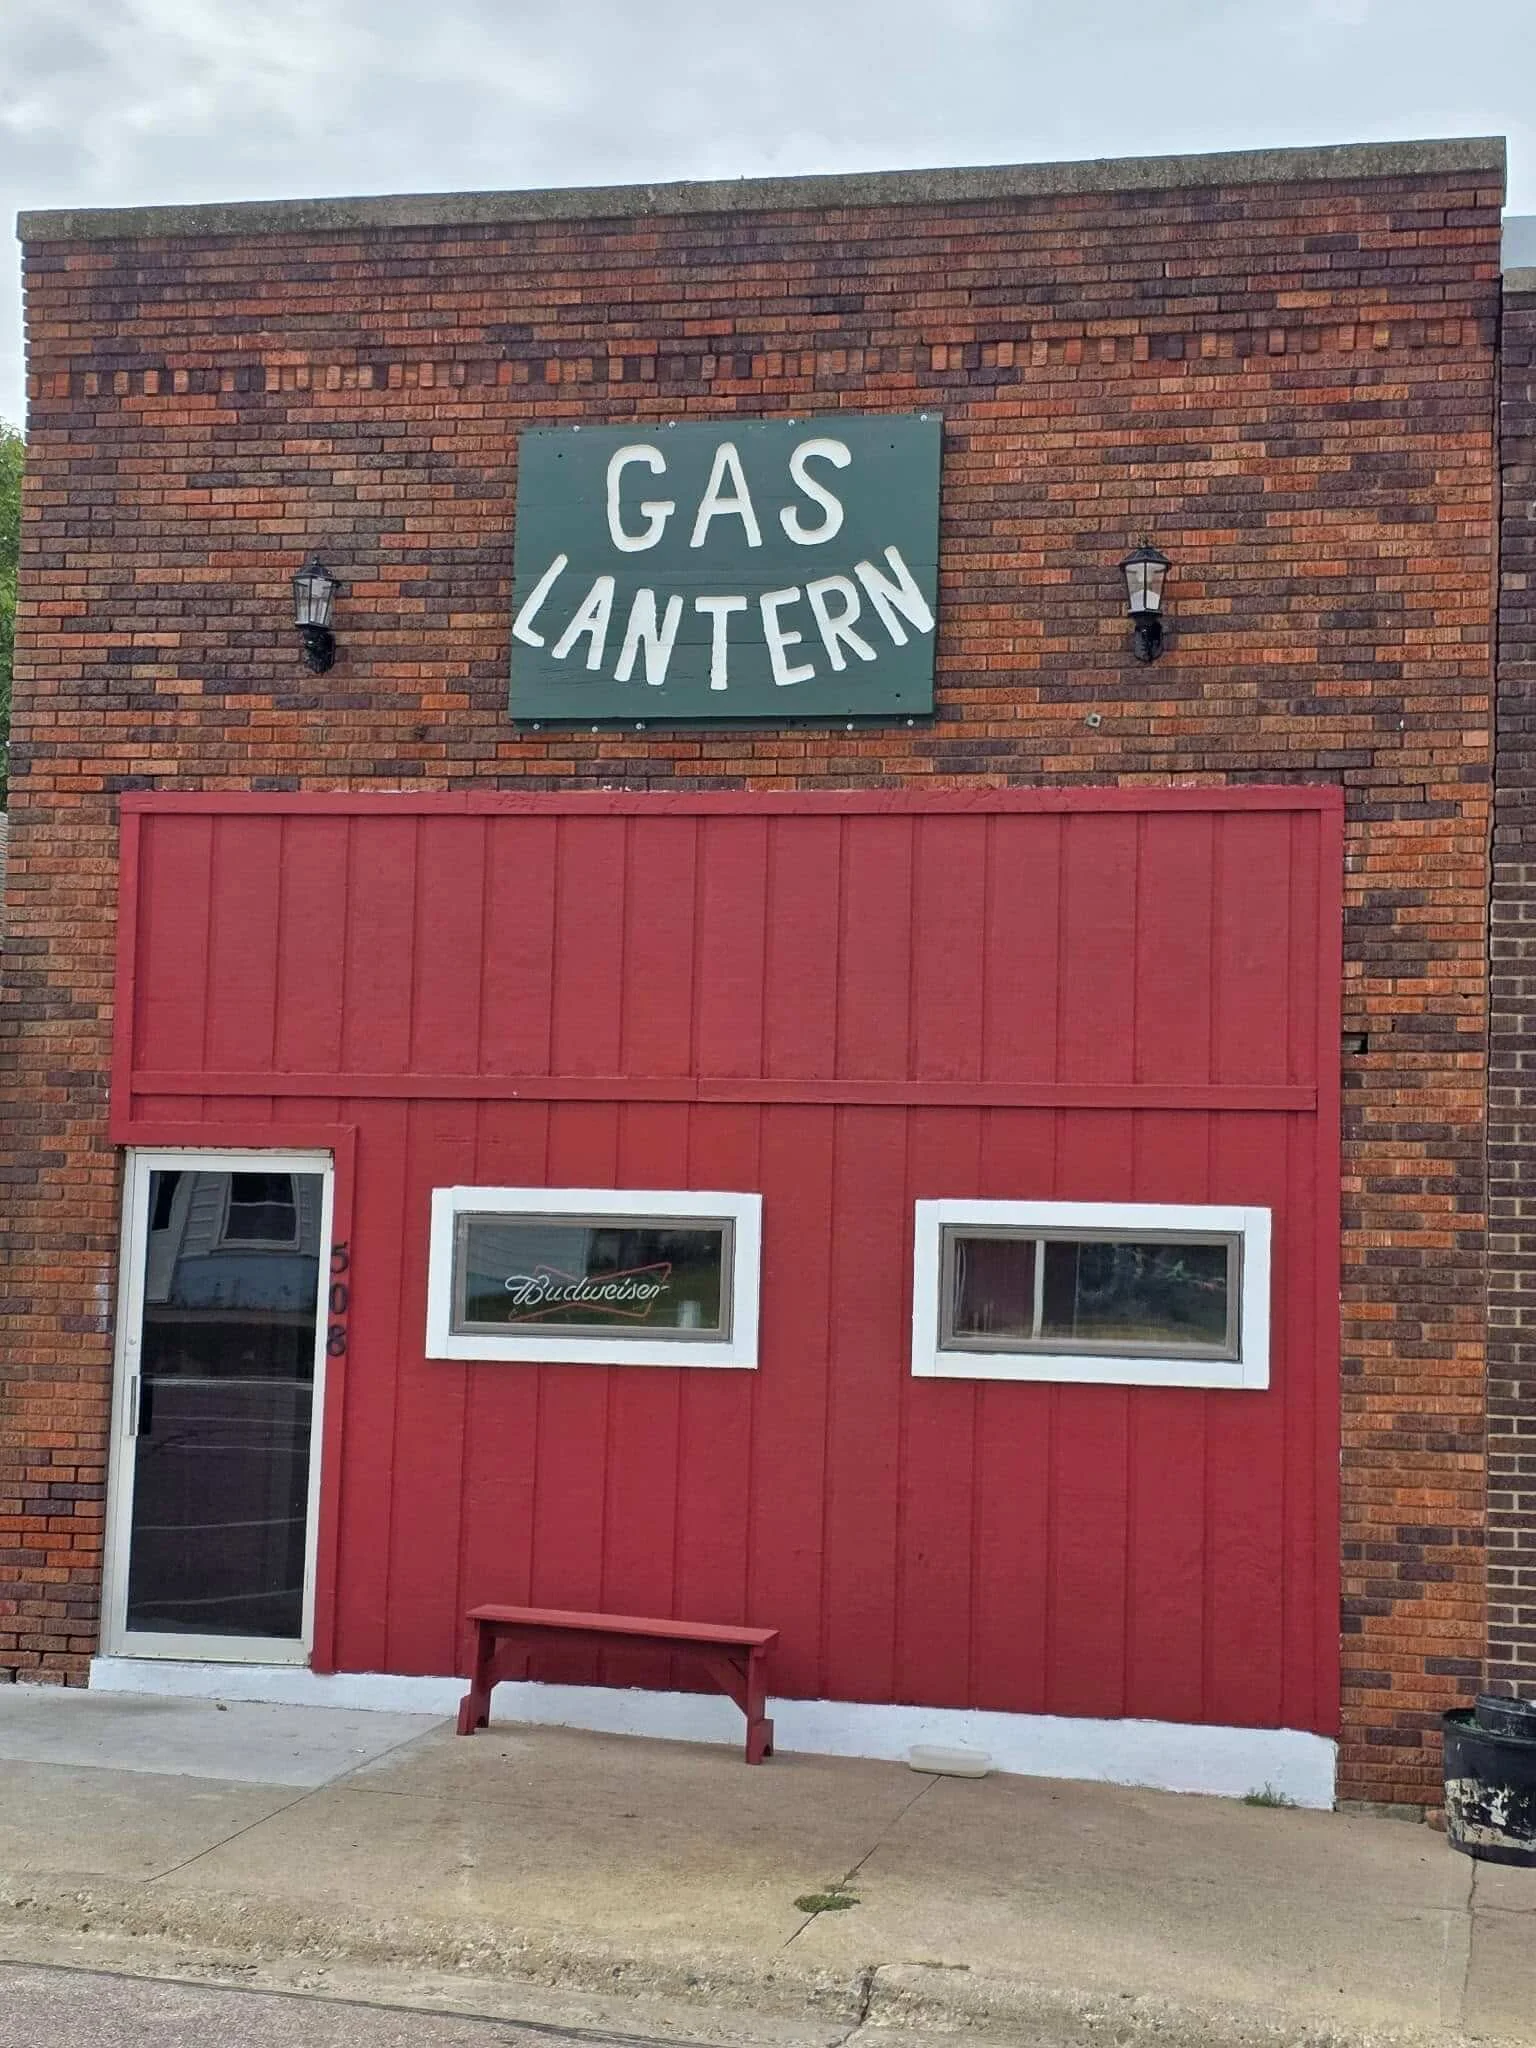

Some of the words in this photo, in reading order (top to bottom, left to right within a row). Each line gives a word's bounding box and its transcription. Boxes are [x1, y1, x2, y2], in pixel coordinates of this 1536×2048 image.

[606, 438, 852, 553] GAS
[511, 545, 936, 691] LANTERN
[326, 1241, 349, 1358] 508
[504, 1275, 671, 1306] Budweiser
